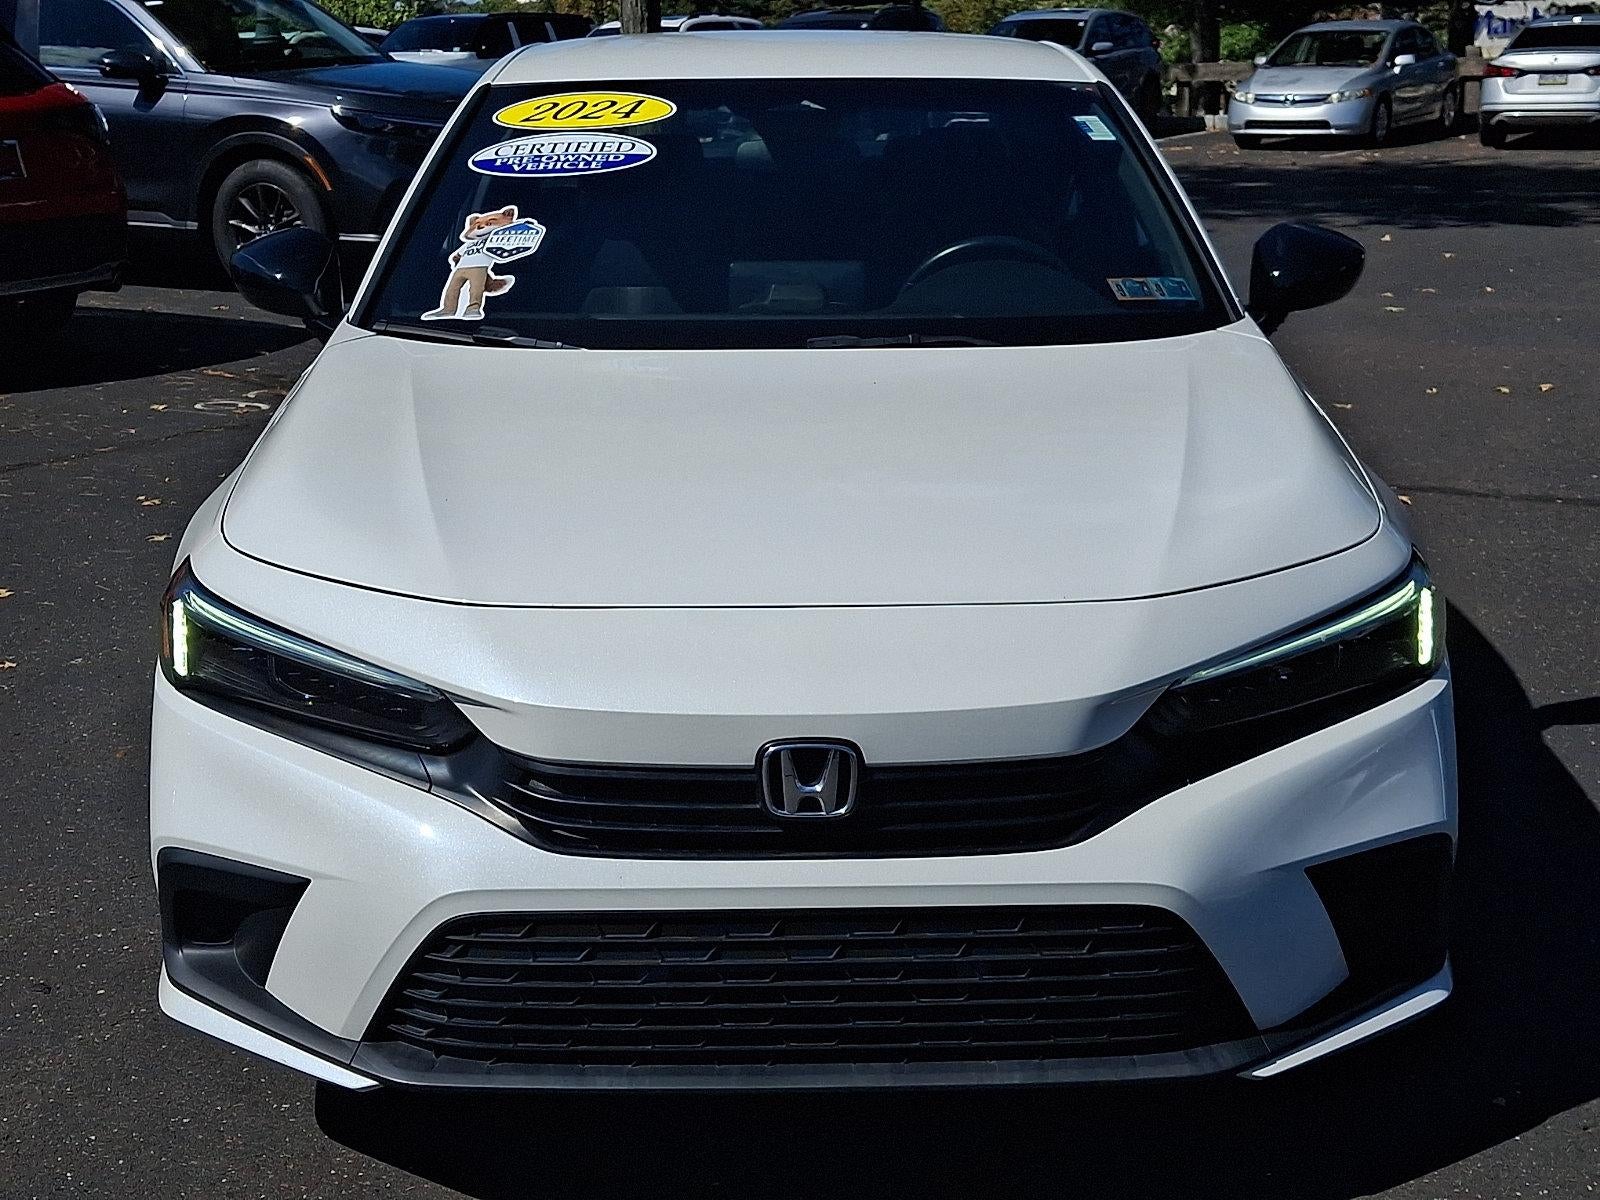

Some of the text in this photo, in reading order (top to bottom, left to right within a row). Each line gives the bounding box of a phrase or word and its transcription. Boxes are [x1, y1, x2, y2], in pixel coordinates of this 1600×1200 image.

[519, 99, 646, 123] 2024
[494, 141, 637, 157] CERTIFIED
[494, 154, 625, 166] PRE-OWNED
[512, 161, 603, 172] VEHICLE
